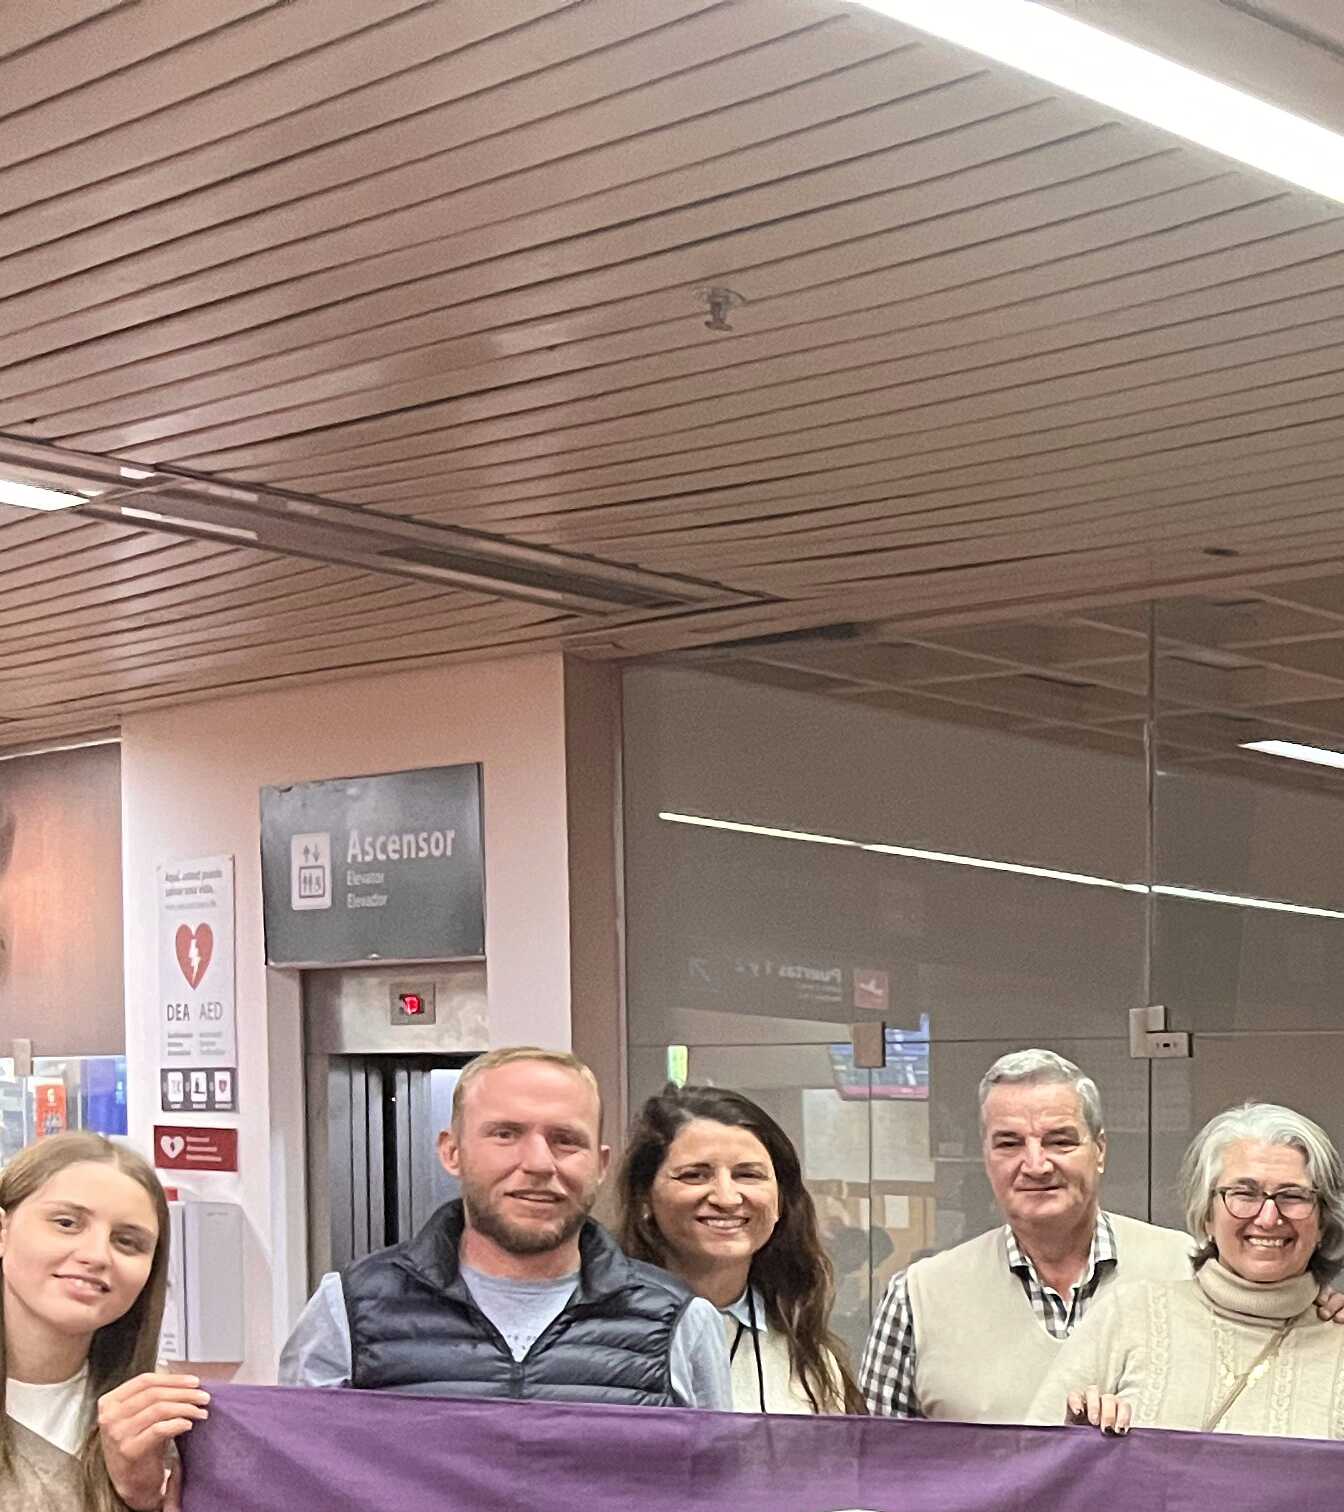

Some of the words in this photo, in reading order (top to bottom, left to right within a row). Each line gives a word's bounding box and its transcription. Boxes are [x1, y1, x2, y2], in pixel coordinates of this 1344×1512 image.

[346, 829, 456, 864] Ascensor
[346, 870, 385, 886] Elevator
[167, 1003, 191, 1021] DEA
[200, 1001, 223, 1020] AED
